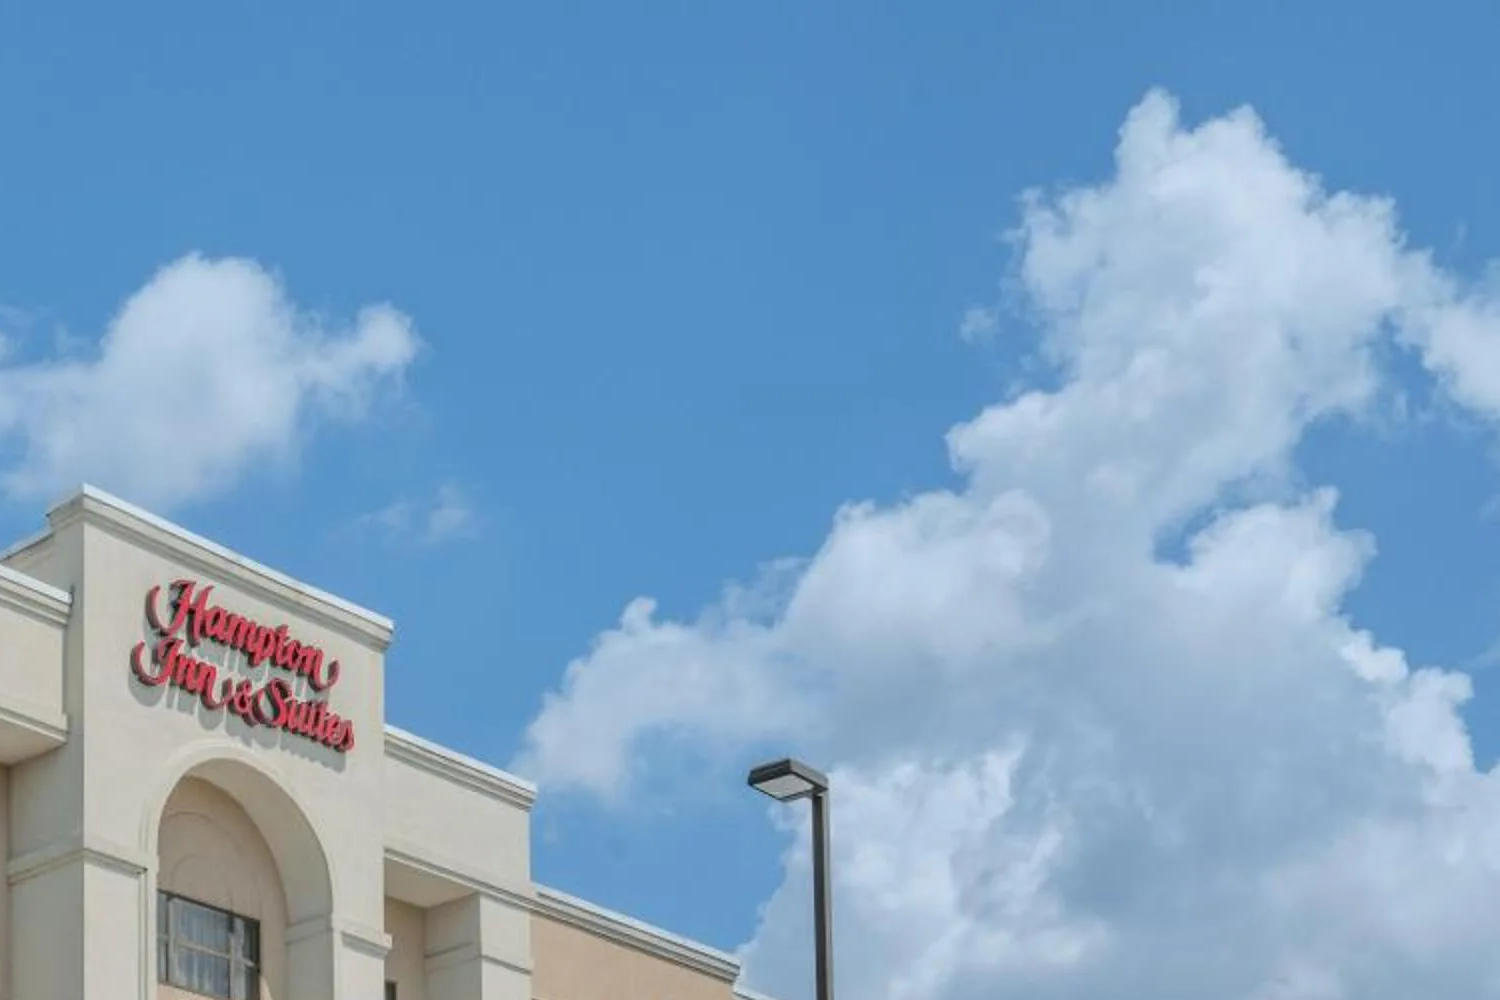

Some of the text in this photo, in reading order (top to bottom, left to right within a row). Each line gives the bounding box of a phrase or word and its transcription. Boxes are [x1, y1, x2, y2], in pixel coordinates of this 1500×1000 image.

[145, 579, 340, 691] Hampton
[131, 638, 355, 752] Inn & Suites
